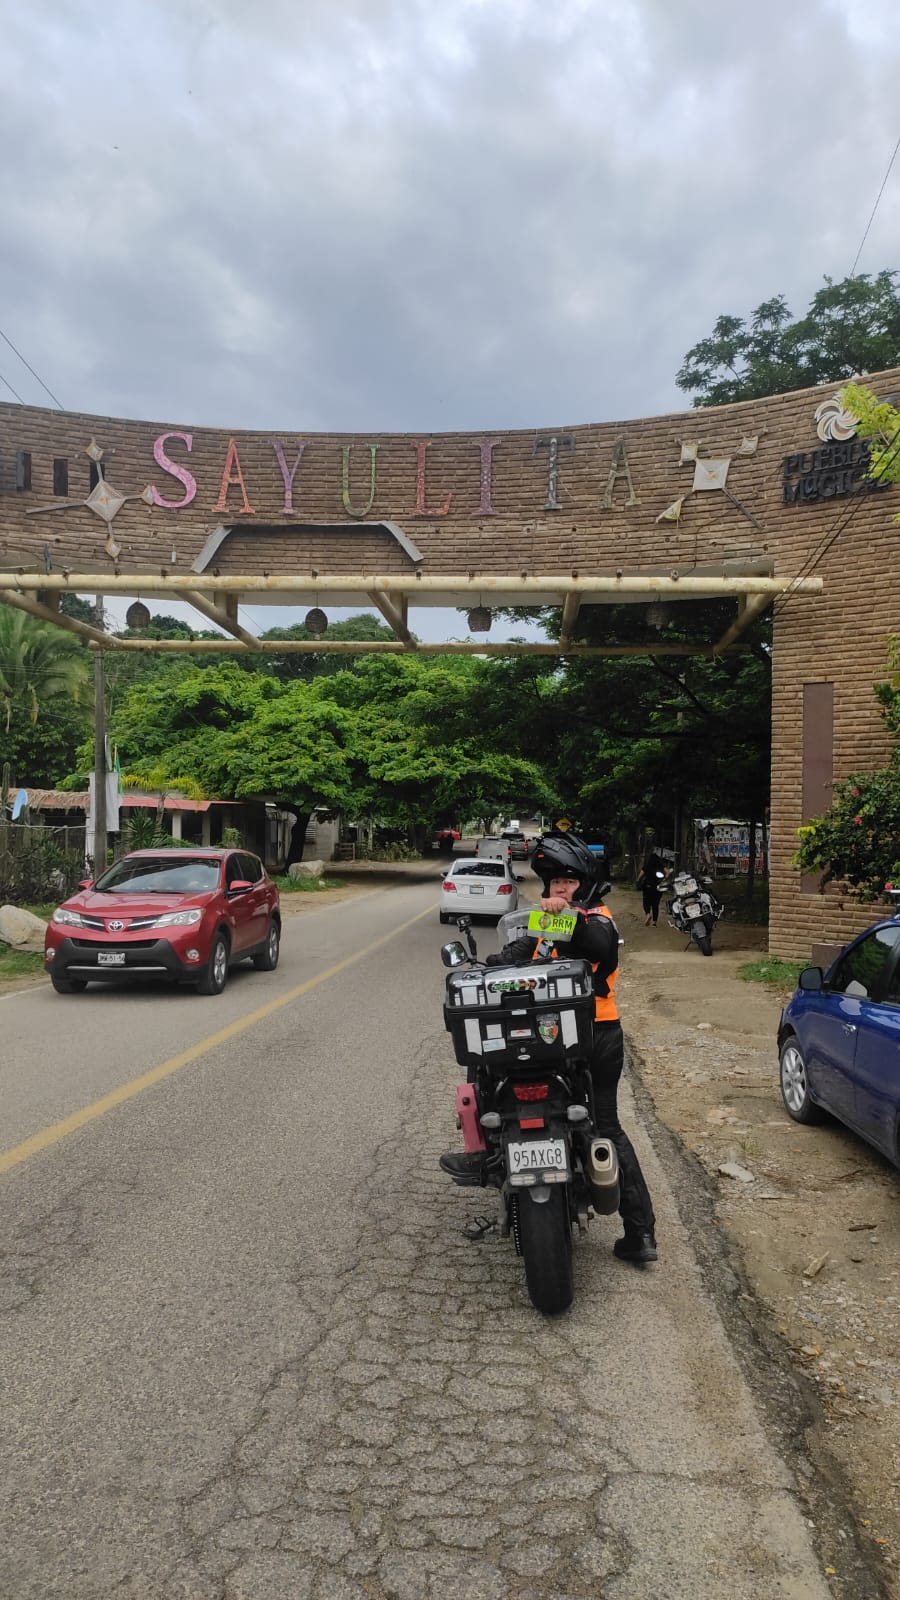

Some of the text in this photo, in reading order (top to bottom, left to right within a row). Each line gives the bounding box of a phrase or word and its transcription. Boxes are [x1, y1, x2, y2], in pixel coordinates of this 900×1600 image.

[153, 431, 642, 517] SAYULITA
[552, 918, 573, 930] RRM
[513, 1147, 563, 1168] 95AXG8
